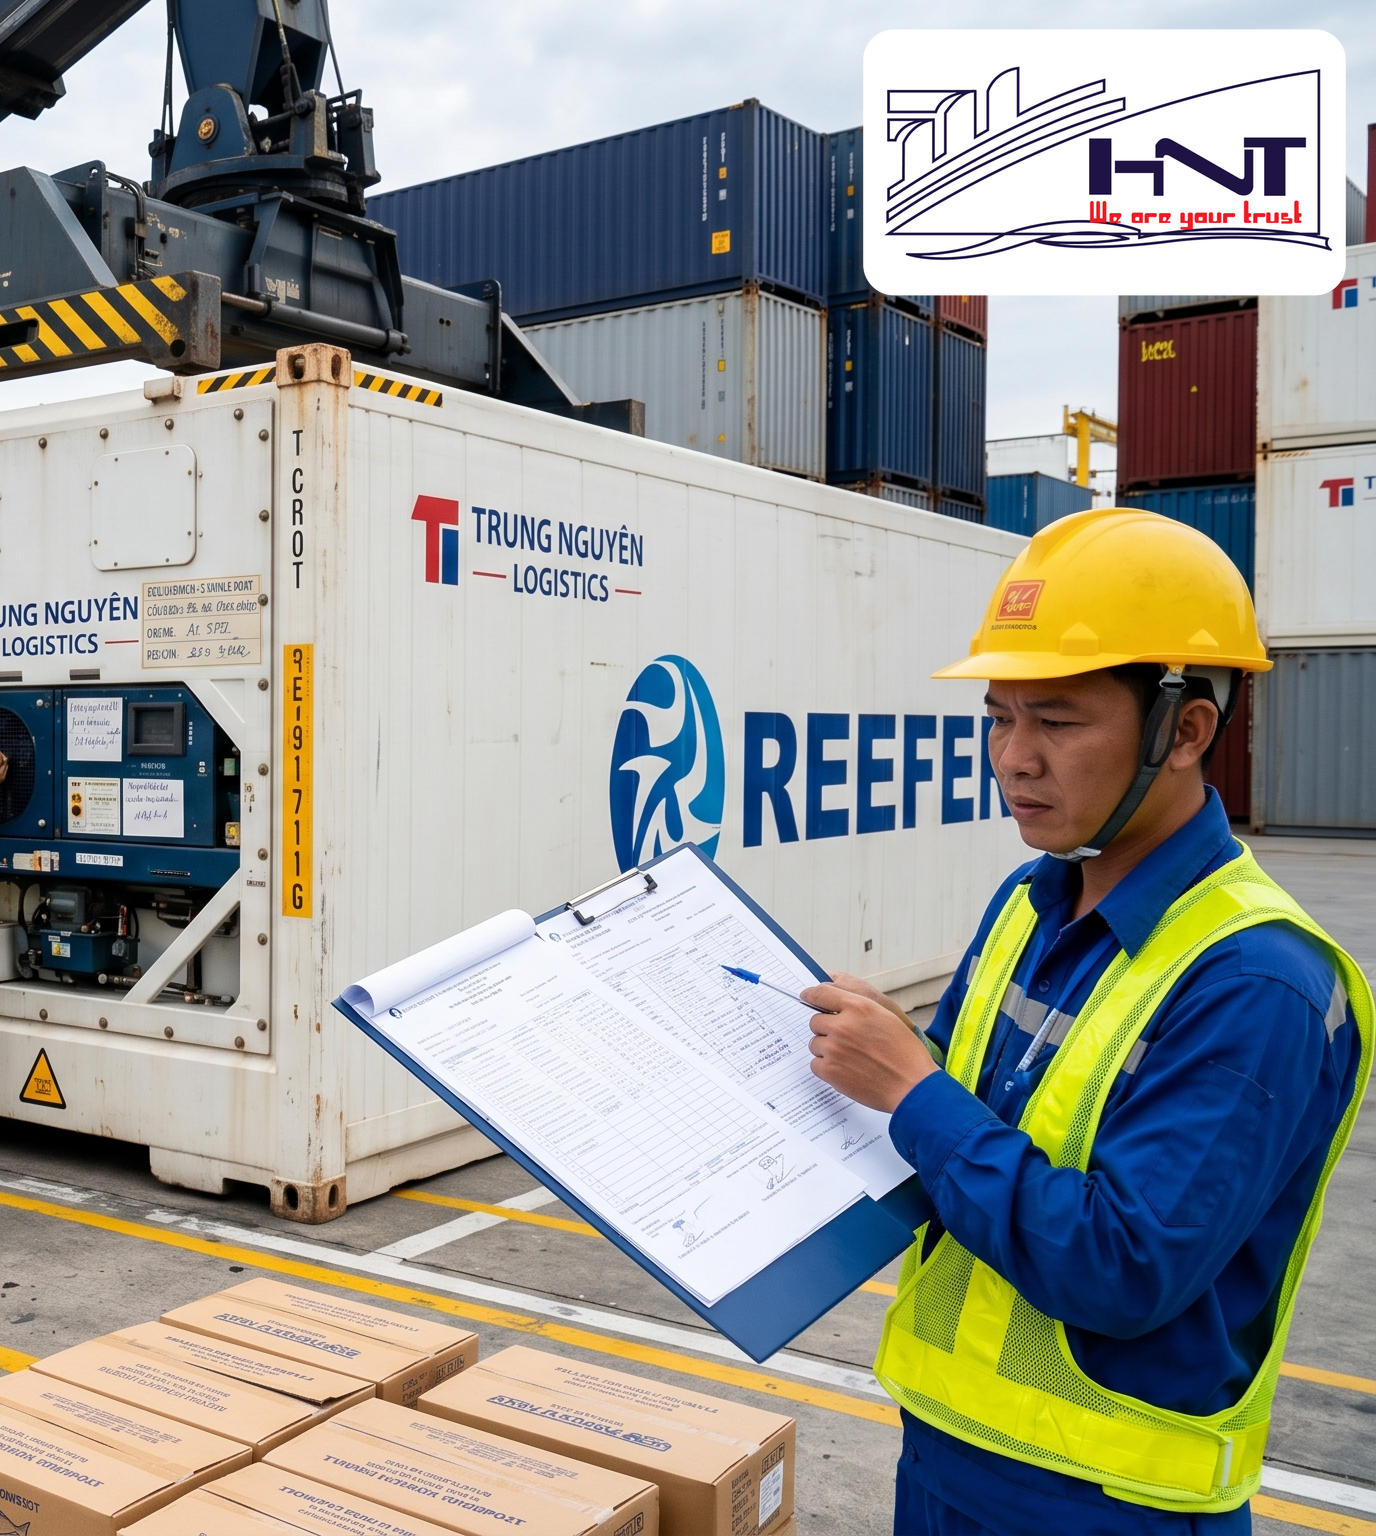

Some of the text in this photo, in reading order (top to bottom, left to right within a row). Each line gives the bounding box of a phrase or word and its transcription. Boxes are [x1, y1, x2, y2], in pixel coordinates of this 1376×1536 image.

[471, 506, 552, 554] TRUNG
[558, 524, 644, 567] NGUYÊN
[513, 563, 609, 602] LOGISTICS
[44, 592, 140, 624] NGUYÊN
[1, 633, 99, 658] LOGISTICS
